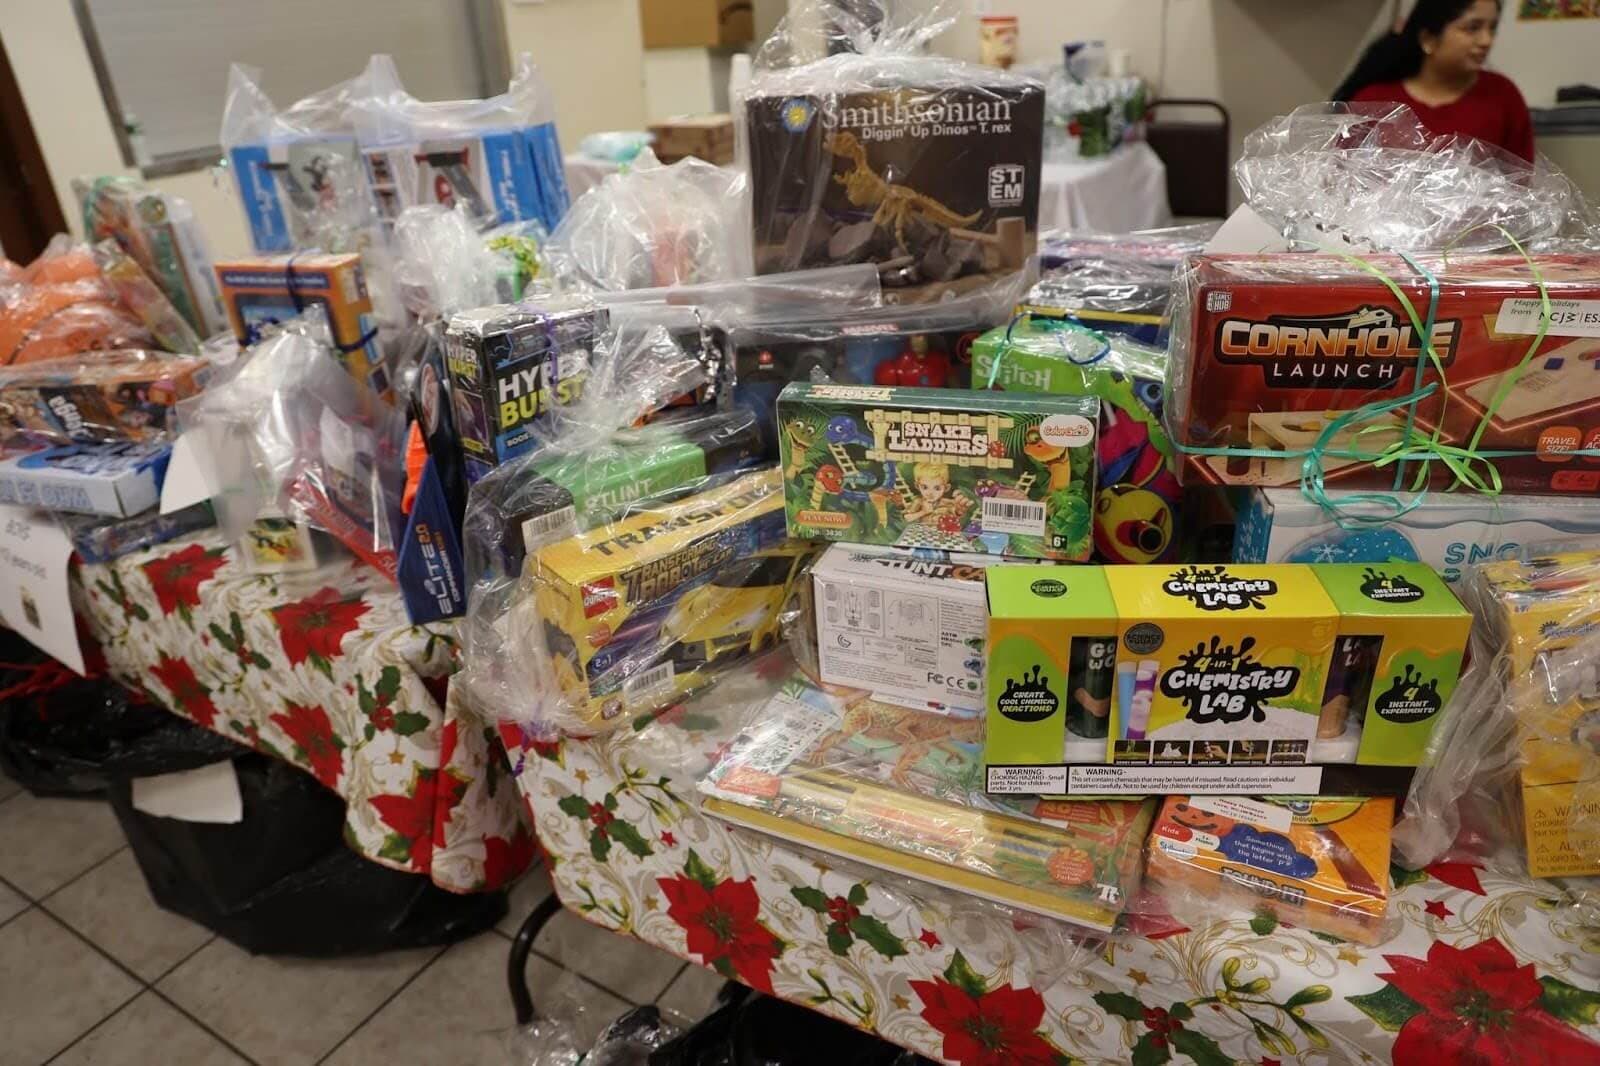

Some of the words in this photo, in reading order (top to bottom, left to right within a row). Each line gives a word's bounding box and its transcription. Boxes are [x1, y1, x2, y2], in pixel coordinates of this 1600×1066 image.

[822, 95, 1012, 129] Smithsonian
[862, 125, 908, 142] Diggin'
[911, 125, 929, 139] Up
[992, 124, 1012, 133] rex
[1221, 320, 1455, 358] CORNHOLE
[1273, 363, 1393, 378] LAUNCH
[904, 423, 972, 438] SNAKE
[889, 429, 988, 456] LADDERS
[1541, 437, 1577, 445] TRAVEL
[1168, 581, 1270, 592] CHEMISTRY
[1381, 580, 1393, 588] 4
[1203, 593, 1242, 606] LAB
[1194, 657, 1241, 672] 4-in-1
[1168, 670, 1293, 691] CHEMISTRY
[1403, 687, 1419, 700] 4
[1200, 692, 1246, 715] LAB
[1389, 700, 1430, 708] INSTANT
[1162, 826, 1180, 835] Kids
[1235, 840, 1250, 848] that
[1251, 844, 1275, 856] begins
[1277, 851, 1293, 861] with
[1246, 836, 1285, 851] Something
[1238, 849, 1250, 857] the
[1252, 852, 1273, 863] letter
